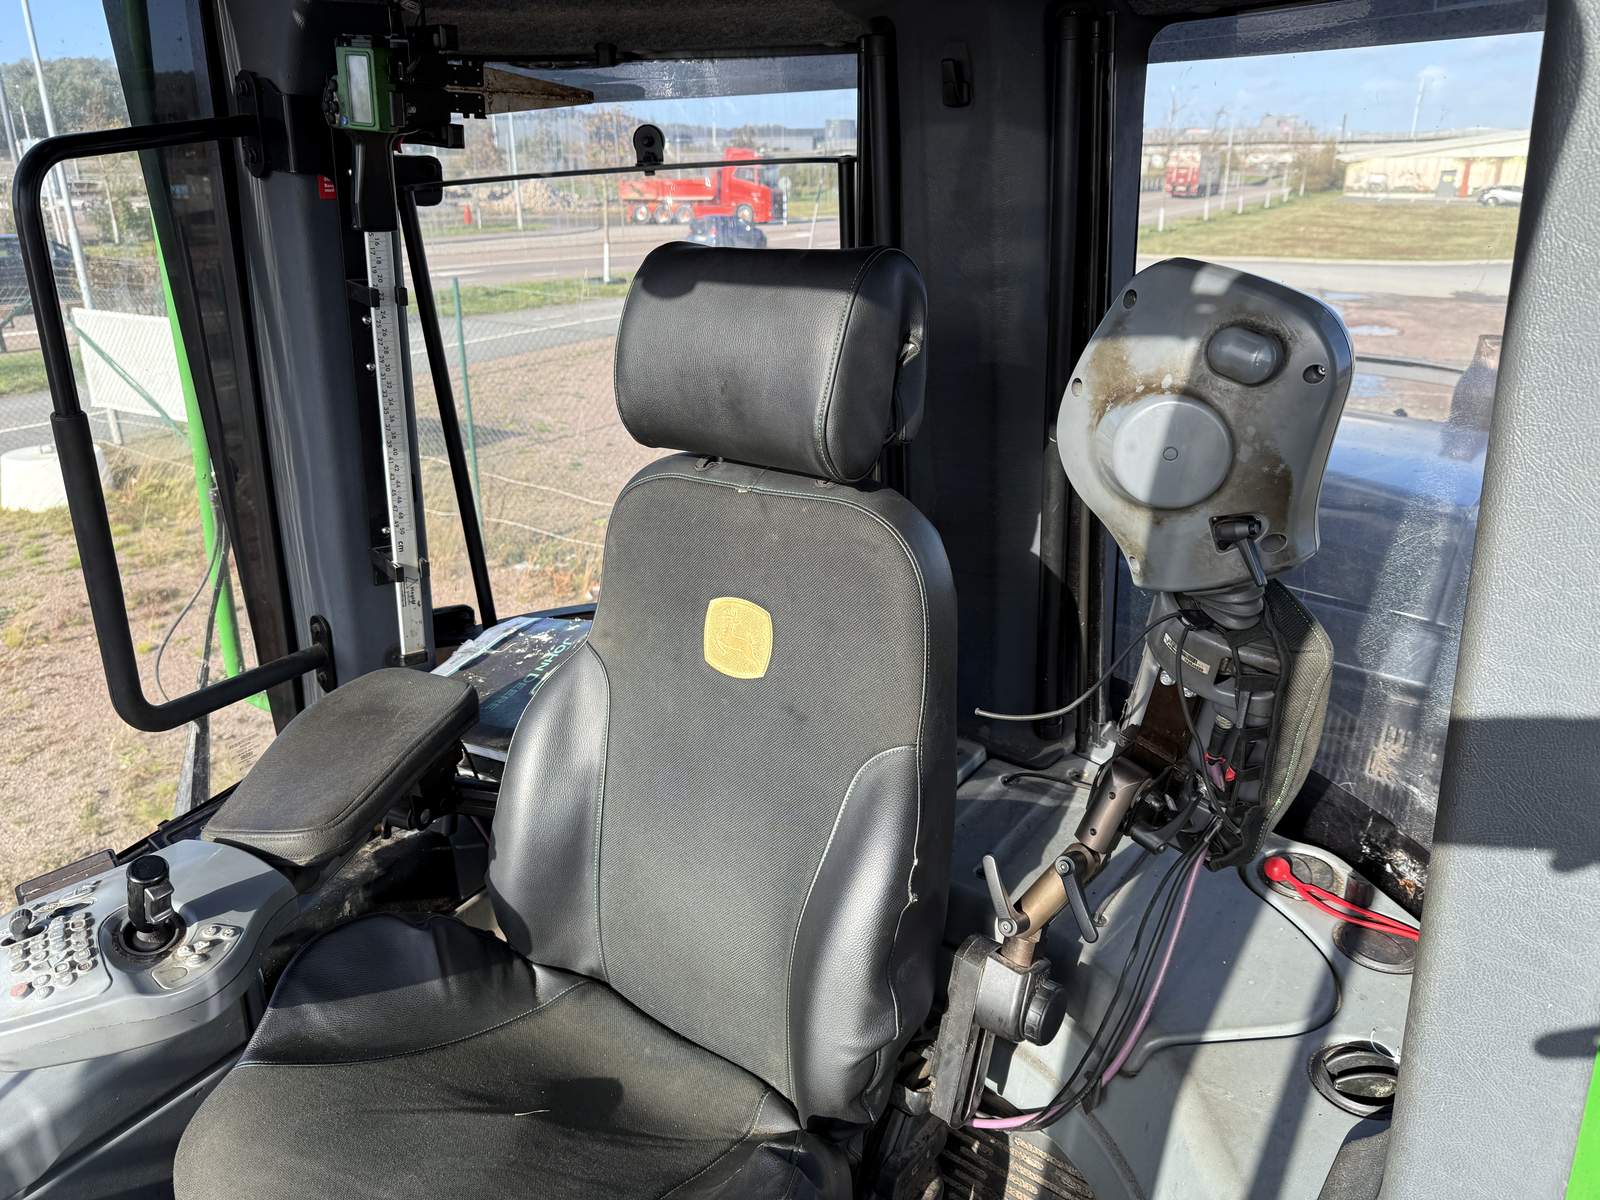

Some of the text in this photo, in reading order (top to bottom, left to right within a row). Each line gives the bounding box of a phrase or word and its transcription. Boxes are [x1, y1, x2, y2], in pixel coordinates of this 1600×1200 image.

[398, 541, 404, 552] cm
[484, 637, 573, 711] JOHN DEERE
